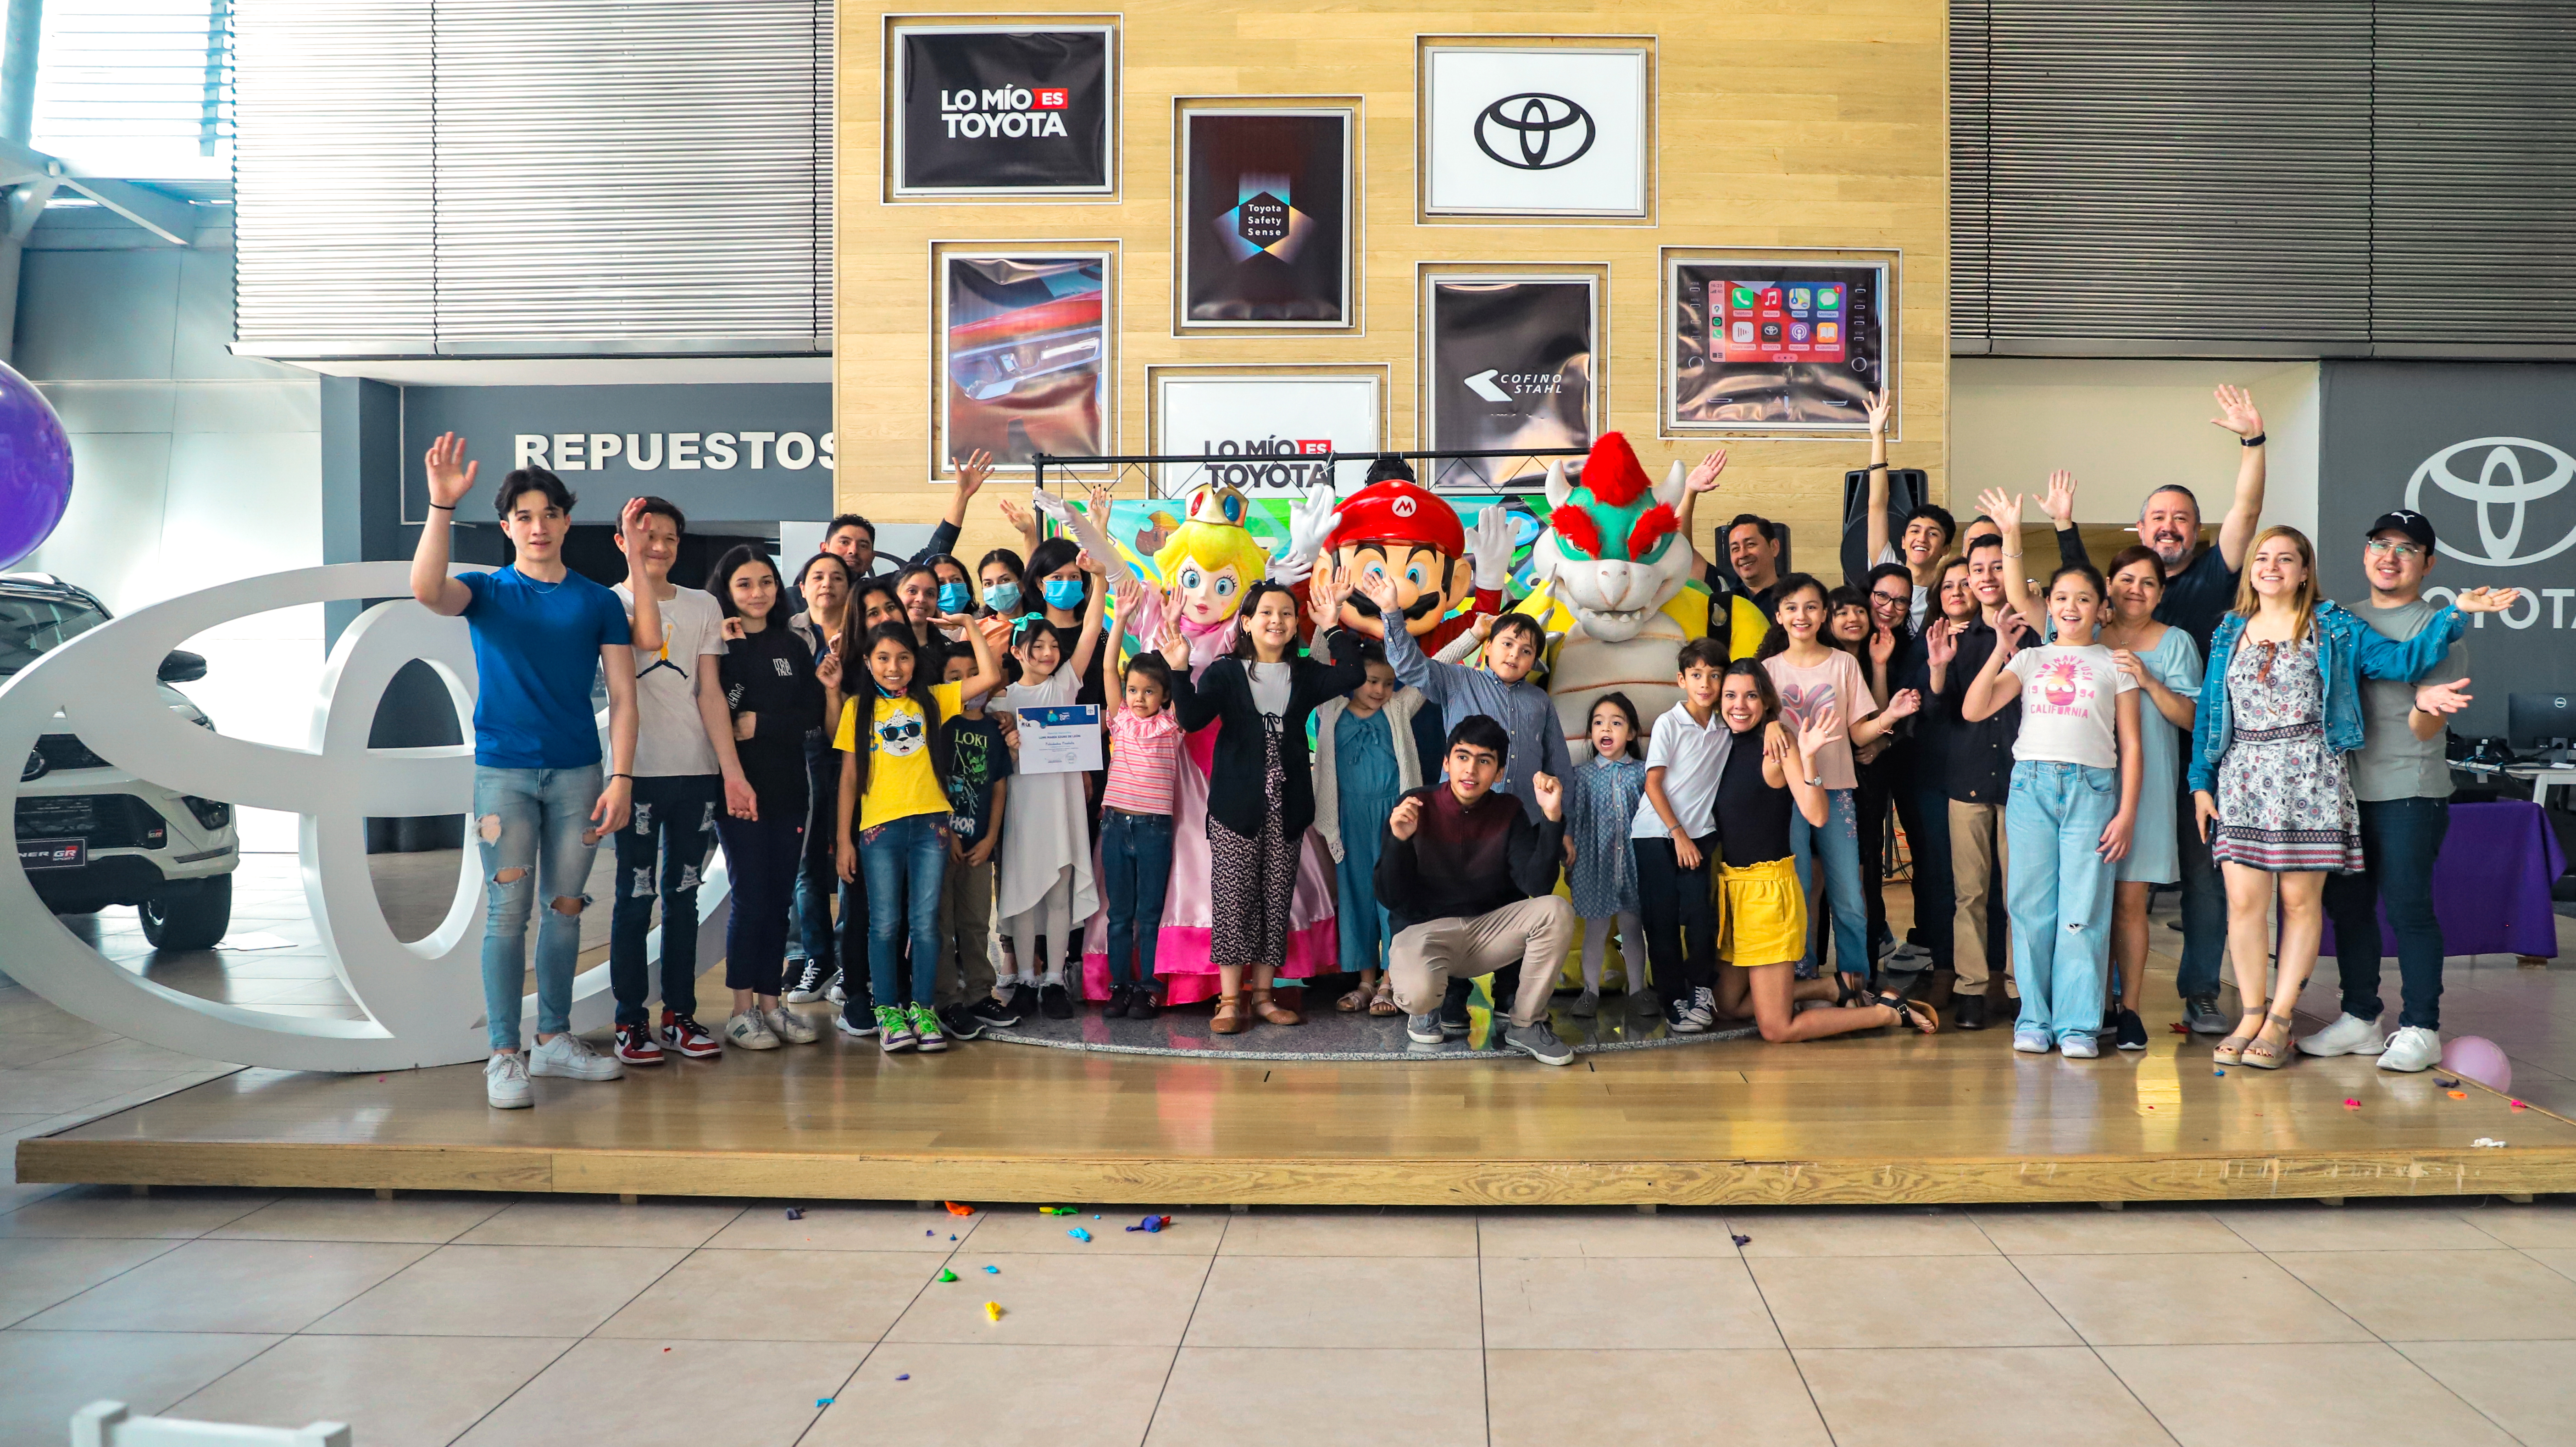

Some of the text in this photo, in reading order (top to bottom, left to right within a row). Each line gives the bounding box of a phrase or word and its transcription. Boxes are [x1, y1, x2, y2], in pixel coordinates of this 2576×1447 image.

[941, 83, 1064, 111] LO MÍO ES
[941, 112, 1068, 138] TOYOTA
[1248, 204, 1282, 214] Toyota
[1248, 216, 1282, 226] Safety
[1514, 384, 1562, 394] STAHL
[1205, 463, 1330, 489] TOYOTA
[1396, 500, 1413, 513] M
[2421, 586, 2576, 629] OYOT
[2053, 655, 2085, 665] NAVY
[2081, 666, 2093, 681] USA
[2079, 689, 2095, 699] 94
[2030, 704, 2089, 719] CALIFORNIA
[954, 729, 988, 748] LOKI
[949, 814, 976, 837] HOR
